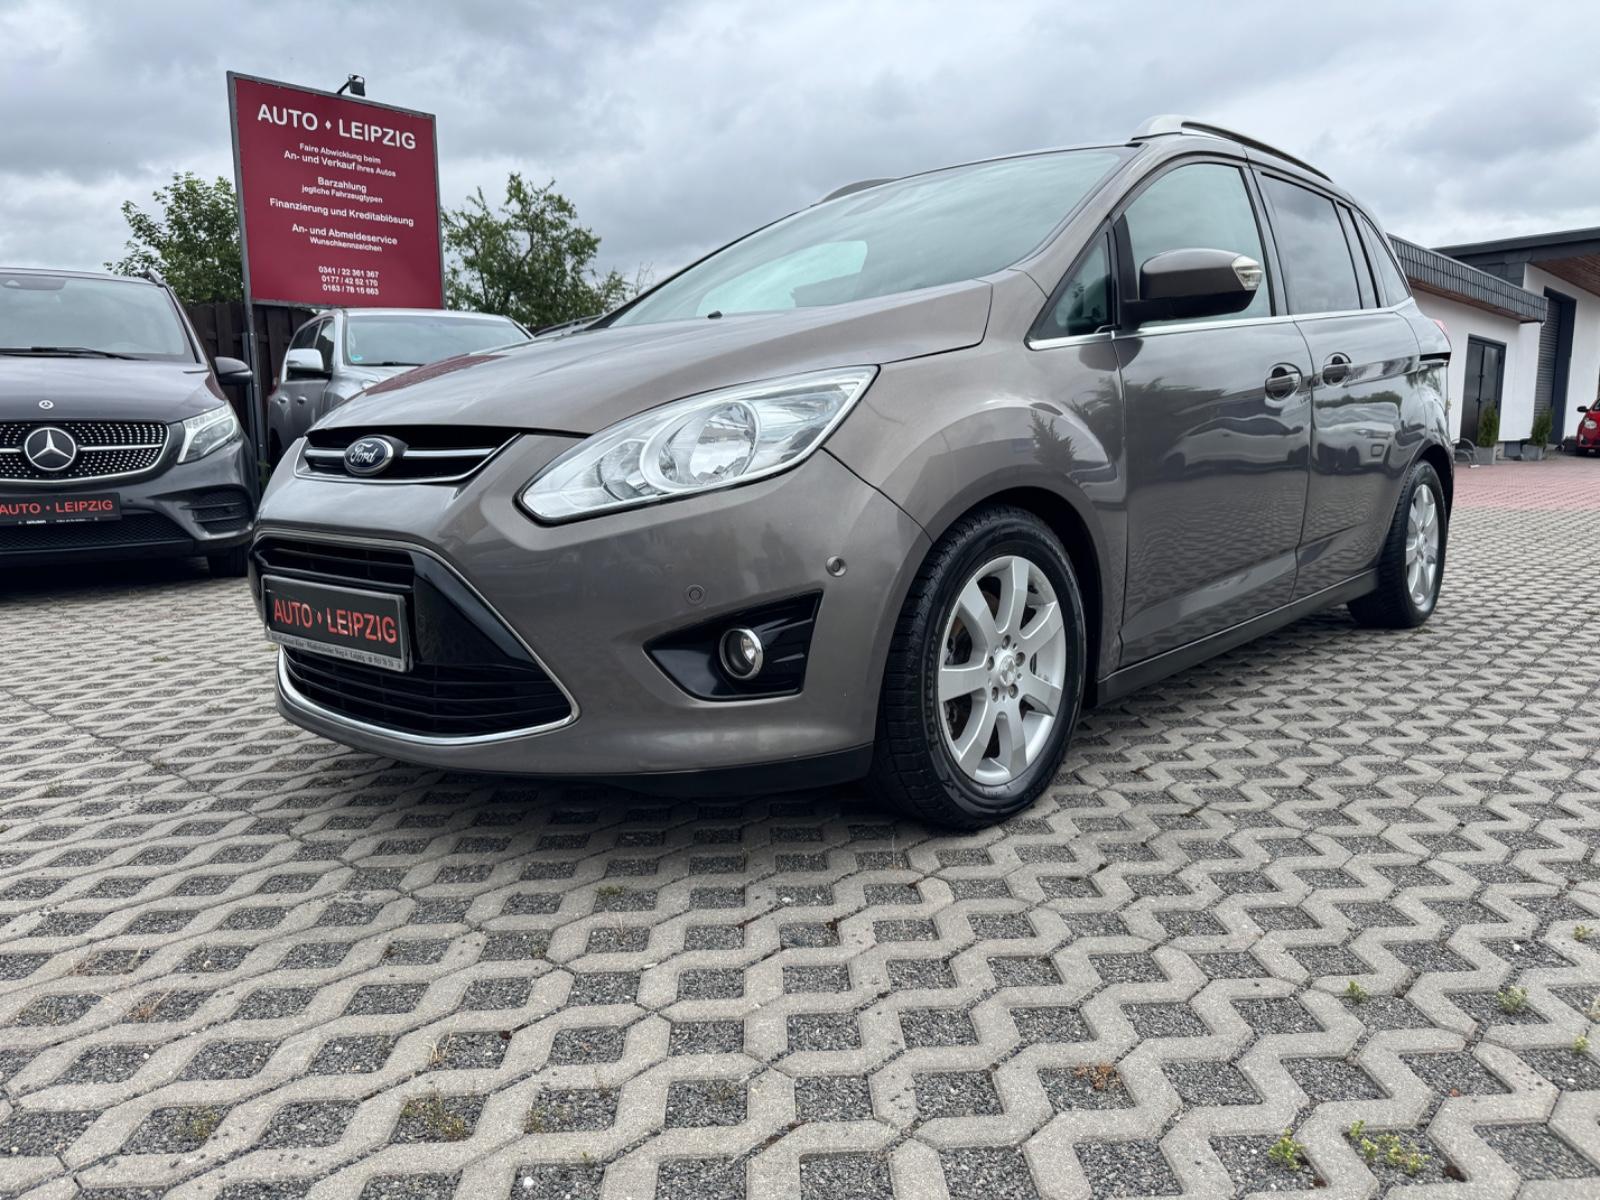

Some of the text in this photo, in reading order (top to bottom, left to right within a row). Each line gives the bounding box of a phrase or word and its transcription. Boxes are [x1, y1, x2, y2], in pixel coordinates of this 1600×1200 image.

[257, 103, 416, 150] AUTO LEIPZIG
[284, 150, 300, 159] An-
[302, 154, 319, 164] und
[321, 156, 356, 170] Verkauf
[376, 167, 396, 177] Autos
[299, 142, 381, 164] Faire Abwicklung beim
[301, 184, 383, 204] jegliche Fahrzeugtypen
[317, 176, 367, 193] Barzahlung
[269, 197, 414, 227] Finanzierung und Kreditablösung
[292, 223, 398, 245] An- und Abmeldeservice
[309, 236, 383, 252] Wunschkennzeichen
[318, 265, 336, 274] 0341
[321, 274, 339, 283] 0177
[344, 277, 353, 285] 42
[350, 442, 379, 464] Ford
[0, 499, 113, 515] AUTO LEIPZIG
[273, 599, 398, 644] AUTO LEIPZIG
